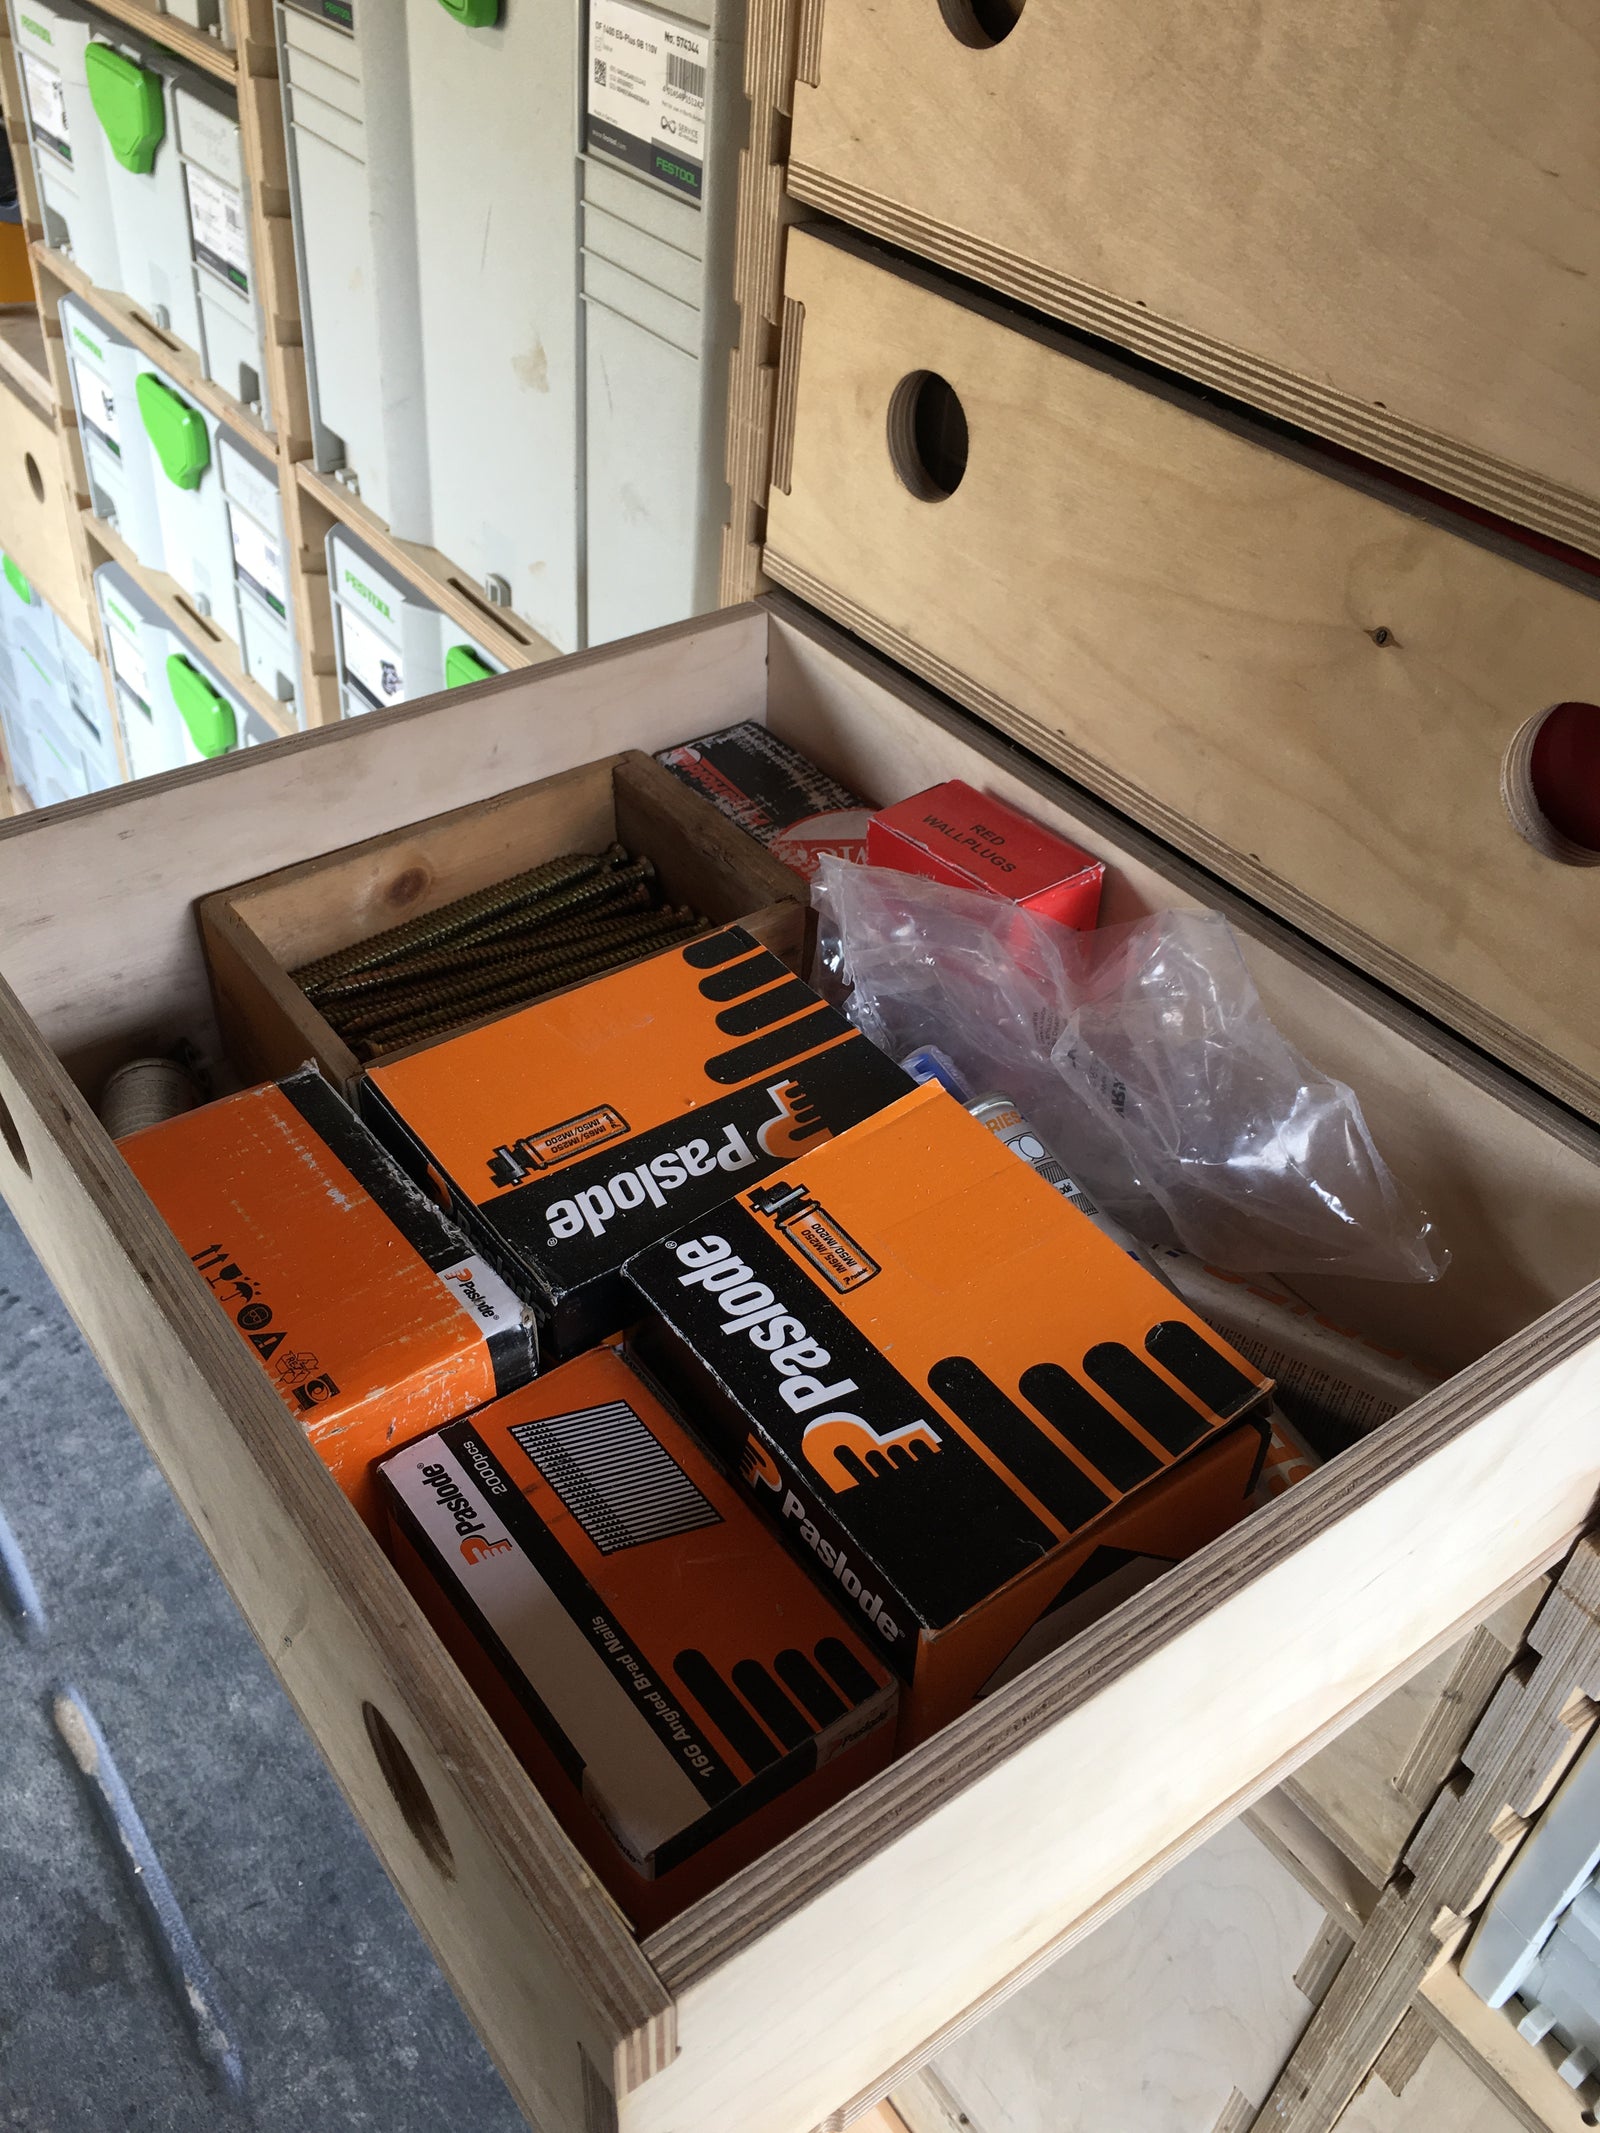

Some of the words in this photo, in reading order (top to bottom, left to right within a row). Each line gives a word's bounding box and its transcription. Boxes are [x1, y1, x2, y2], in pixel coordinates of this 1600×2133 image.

[656, 156, 698, 187] FESTOOL
[922, 814, 1017, 874] WALLPLUGS
[970, 822, 1006, 847] RED
[545, 1118, 600, 1147] IM50/IM200
[551, 1124, 607, 1154] IM65/IM250
[545, 1123, 757, 1238] Paslode
[801, 1229, 848, 1273] IM65/IM250
[811, 1222, 857, 1267] IM50/IM200
[459, 1280, 495, 1319] Paslode
[675, 1235, 859, 1414] Paslode
[464, 1440, 507, 1495] 2000pcs
[422, 1462, 486, 1538] Paslode
[781, 1489, 898, 1642] Paslode
[591, 1615, 624, 1653] Nails
[616, 1651, 652, 1691] Brad
[644, 1693, 691, 1742] Angled
[683, 1743, 716, 1778] 16G
